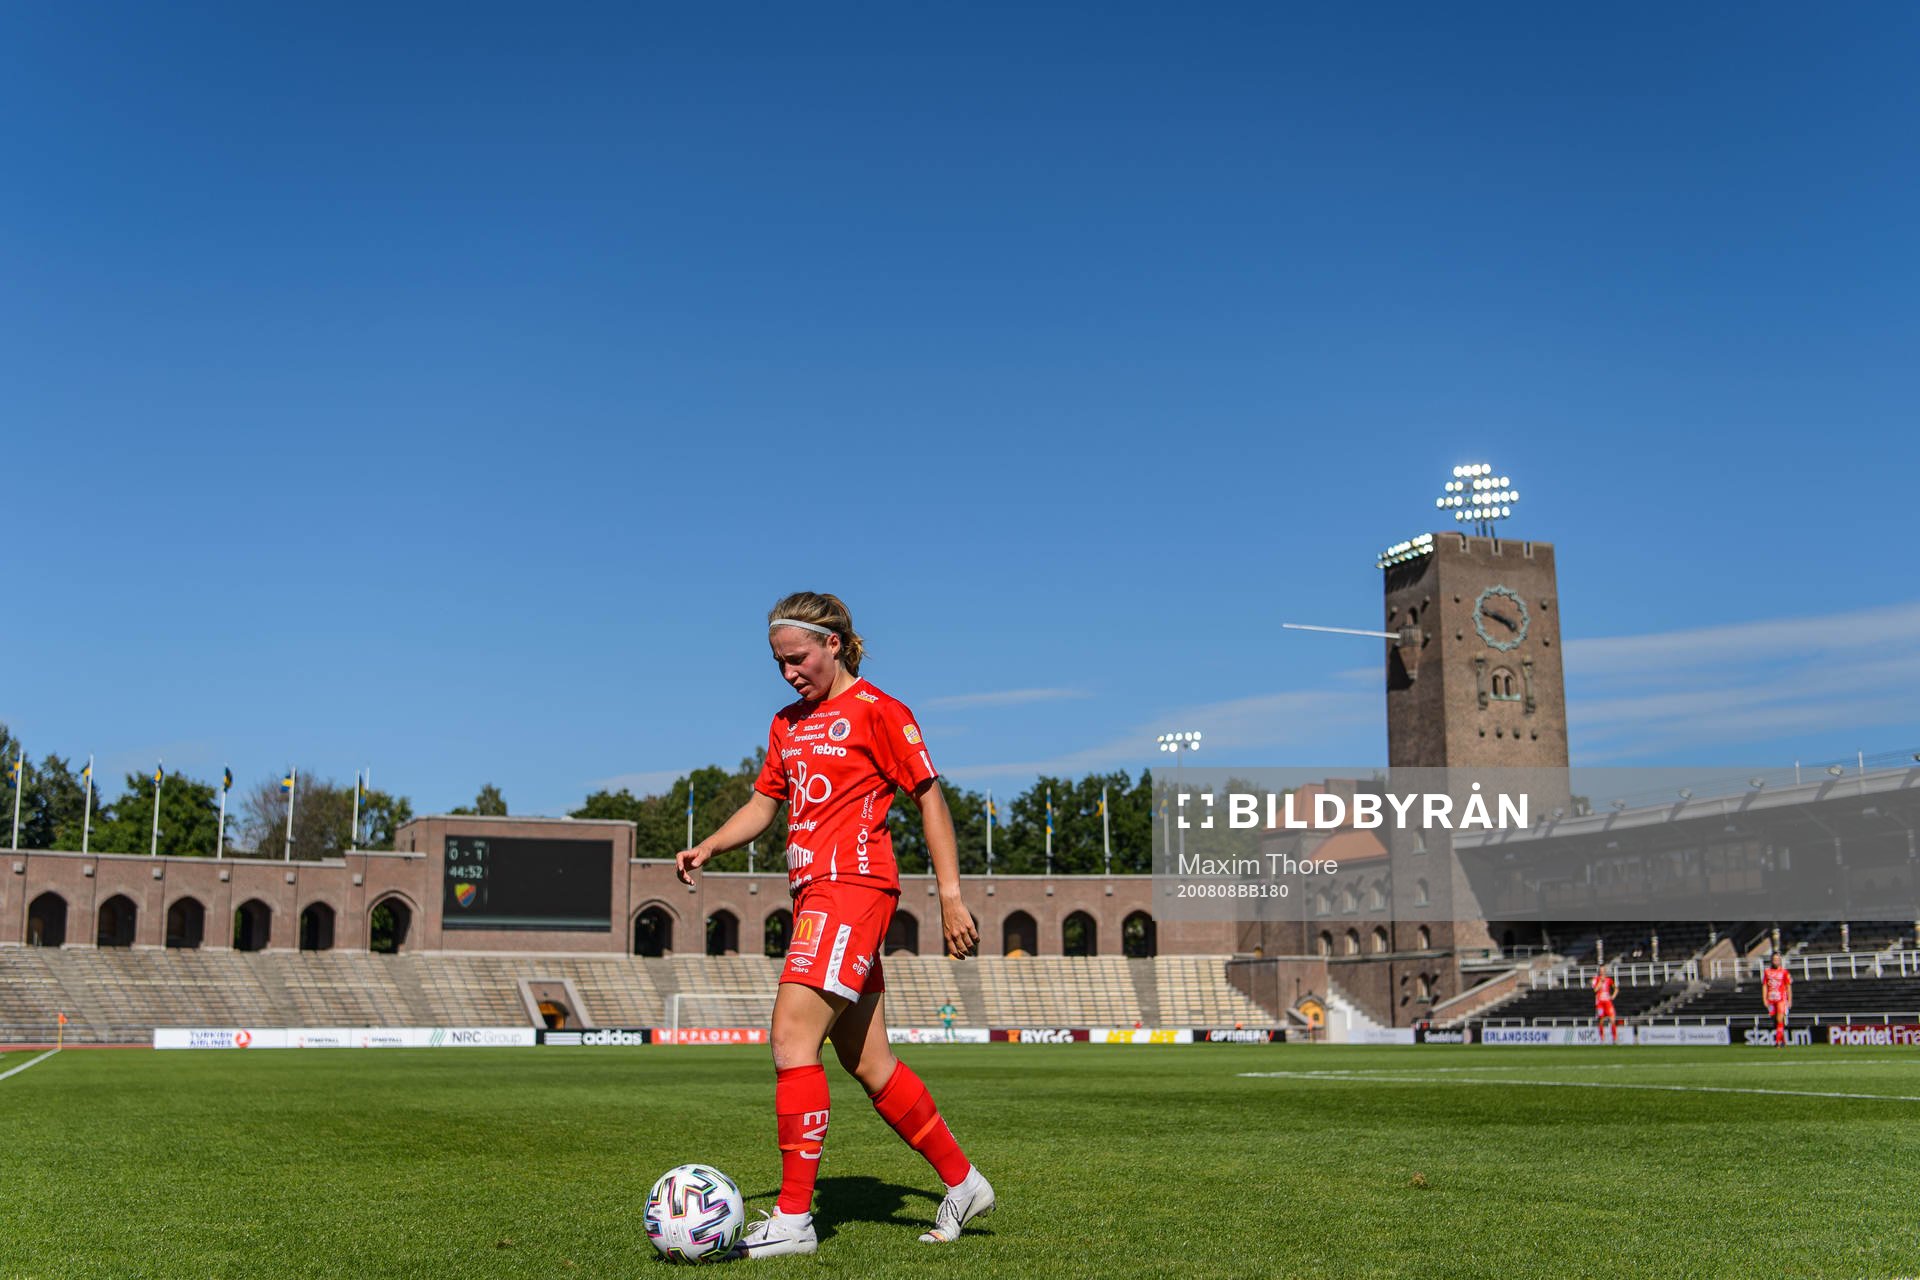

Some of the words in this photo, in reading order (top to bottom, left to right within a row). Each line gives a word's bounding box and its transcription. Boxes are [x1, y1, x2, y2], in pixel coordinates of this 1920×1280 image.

[787, 761, 832, 817] BO
[857, 828, 870, 875] RICO
[452, 1031, 481, 1043] NRC
[484, 1031, 521, 1046] Group
[583, 1029, 642, 1045] adidas
[1744, 1027, 1812, 1045] stadum
[1829, 1026, 1892, 1045] Prioritet
